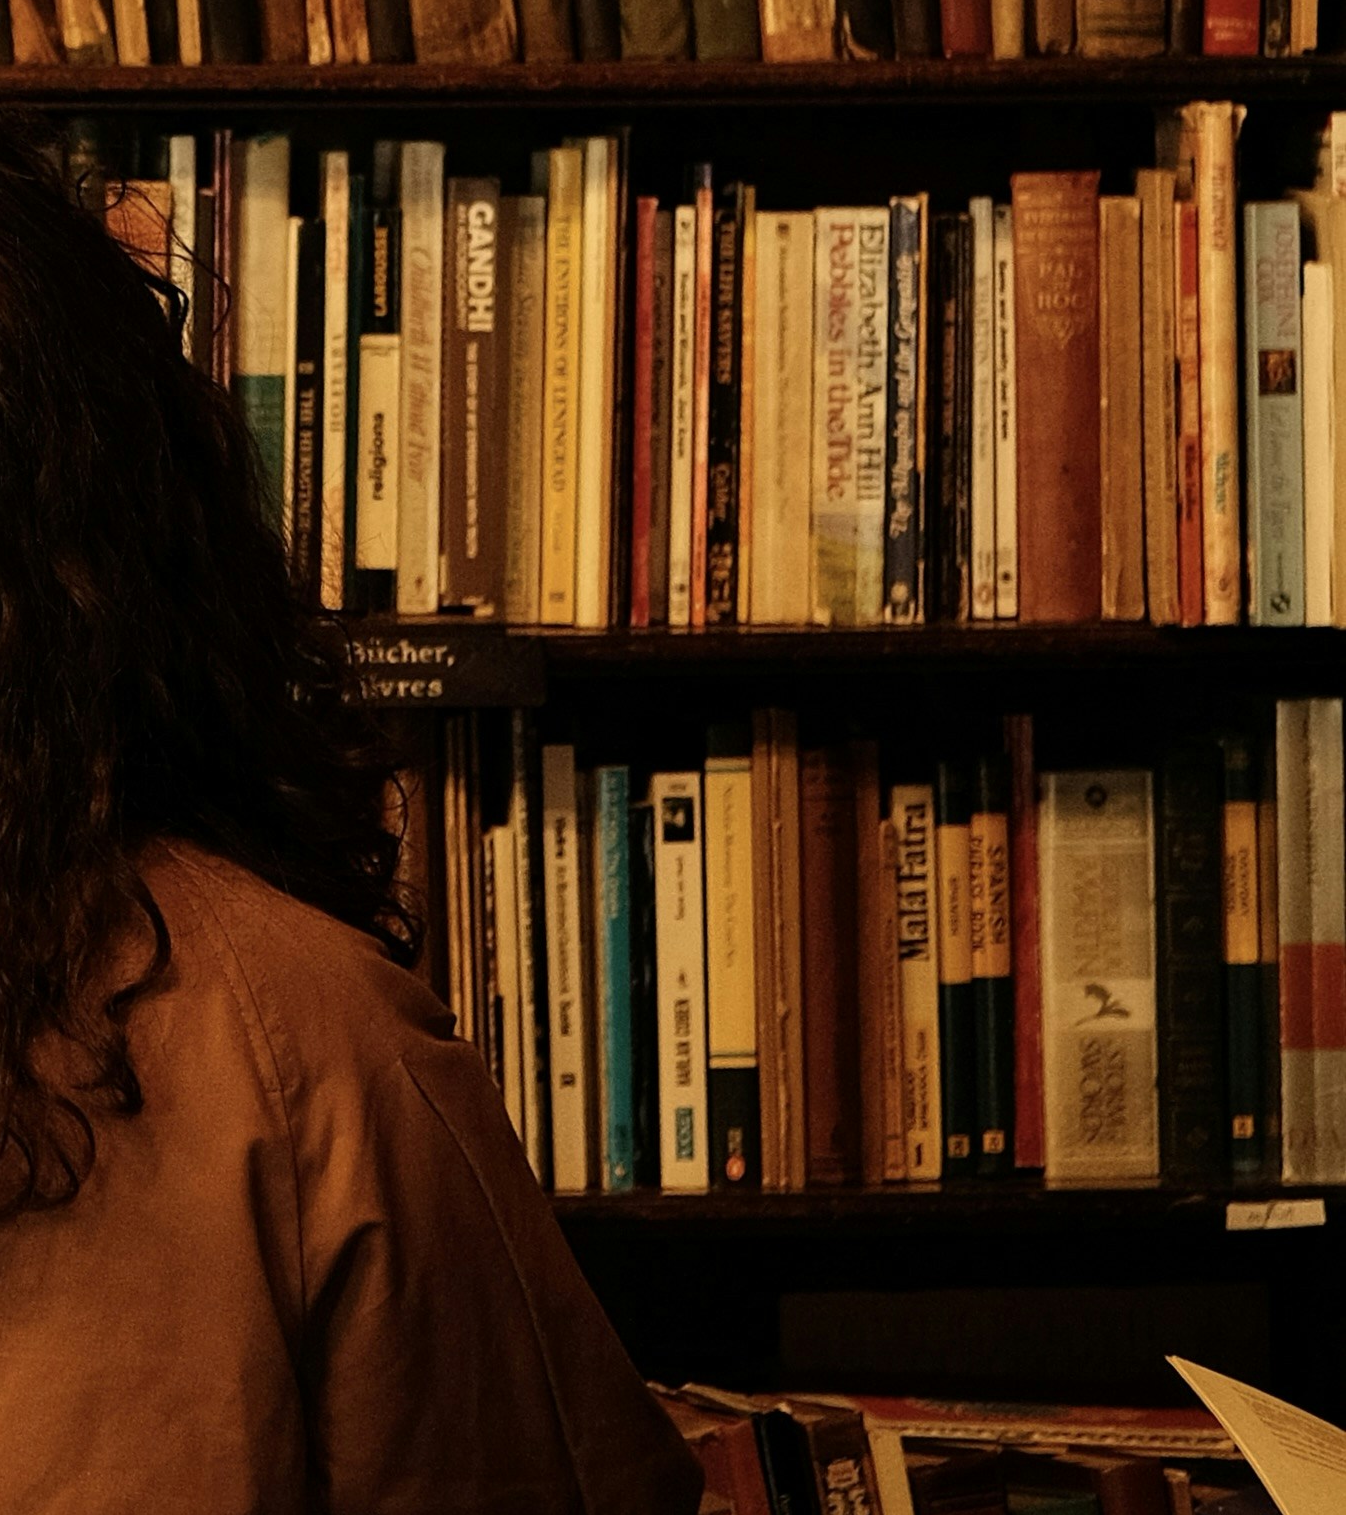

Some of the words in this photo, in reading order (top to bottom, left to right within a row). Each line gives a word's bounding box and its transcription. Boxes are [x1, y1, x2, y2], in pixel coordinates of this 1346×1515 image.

[466, 200, 496, 333] GANDHI
[554, 258, 572, 351] ENVIRONS
[827, 222, 855, 343] Pebbles
[857, 222, 886, 370] Elizabeth
[554, 357, 571, 381] OF
[827, 348, 853, 377] in
[552, 384, 571, 493] LENINGRAD
[826, 383, 853, 433] the
[856, 376, 884, 440] Ann
[371, 412, 388, 501] religions
[856, 445, 883, 502] Hill
[896, 802, 929, 884] Fatra
[989, 845, 1008, 946] SPANISH
